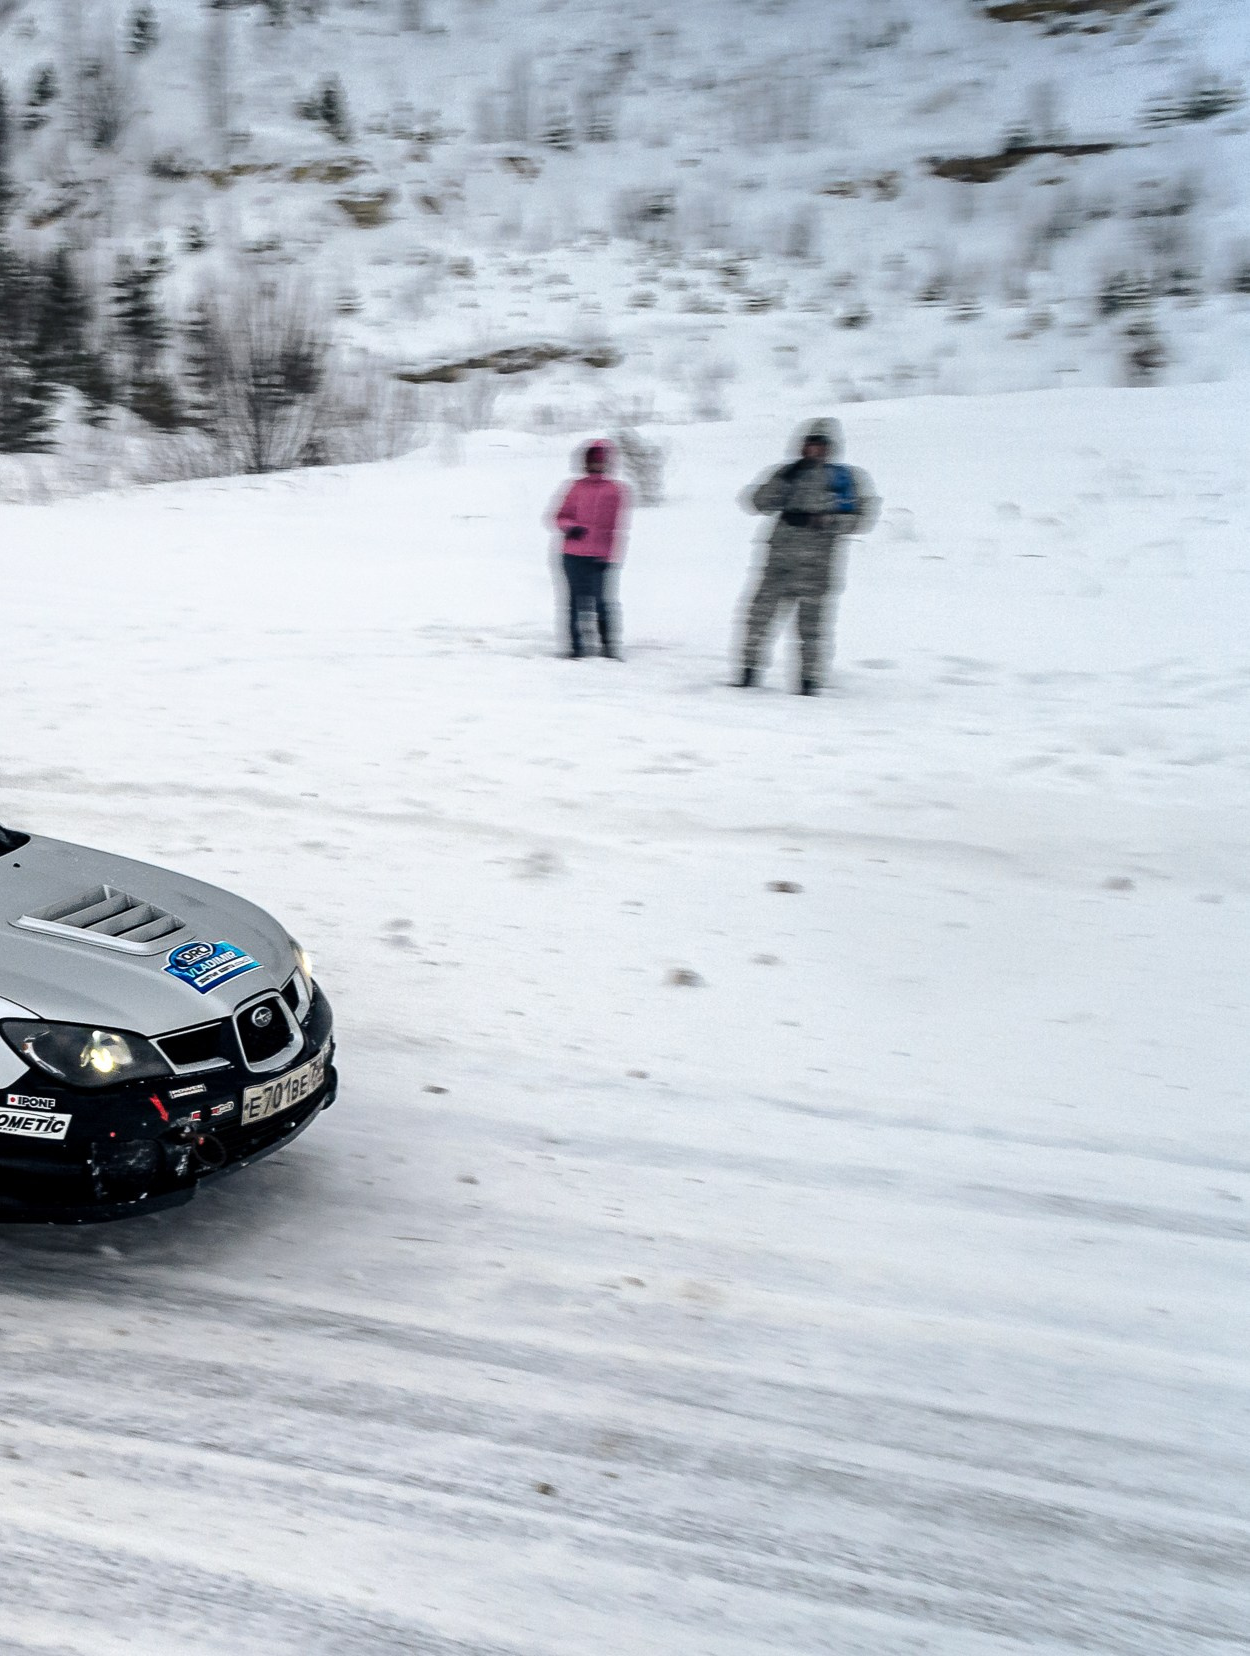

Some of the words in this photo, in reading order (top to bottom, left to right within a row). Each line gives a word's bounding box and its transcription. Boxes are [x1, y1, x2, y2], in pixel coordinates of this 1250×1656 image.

[181, 945, 210, 961] ORC
[186, 950, 238, 978] VLADIMIR
[18, 1096, 55, 1109] IPONE
